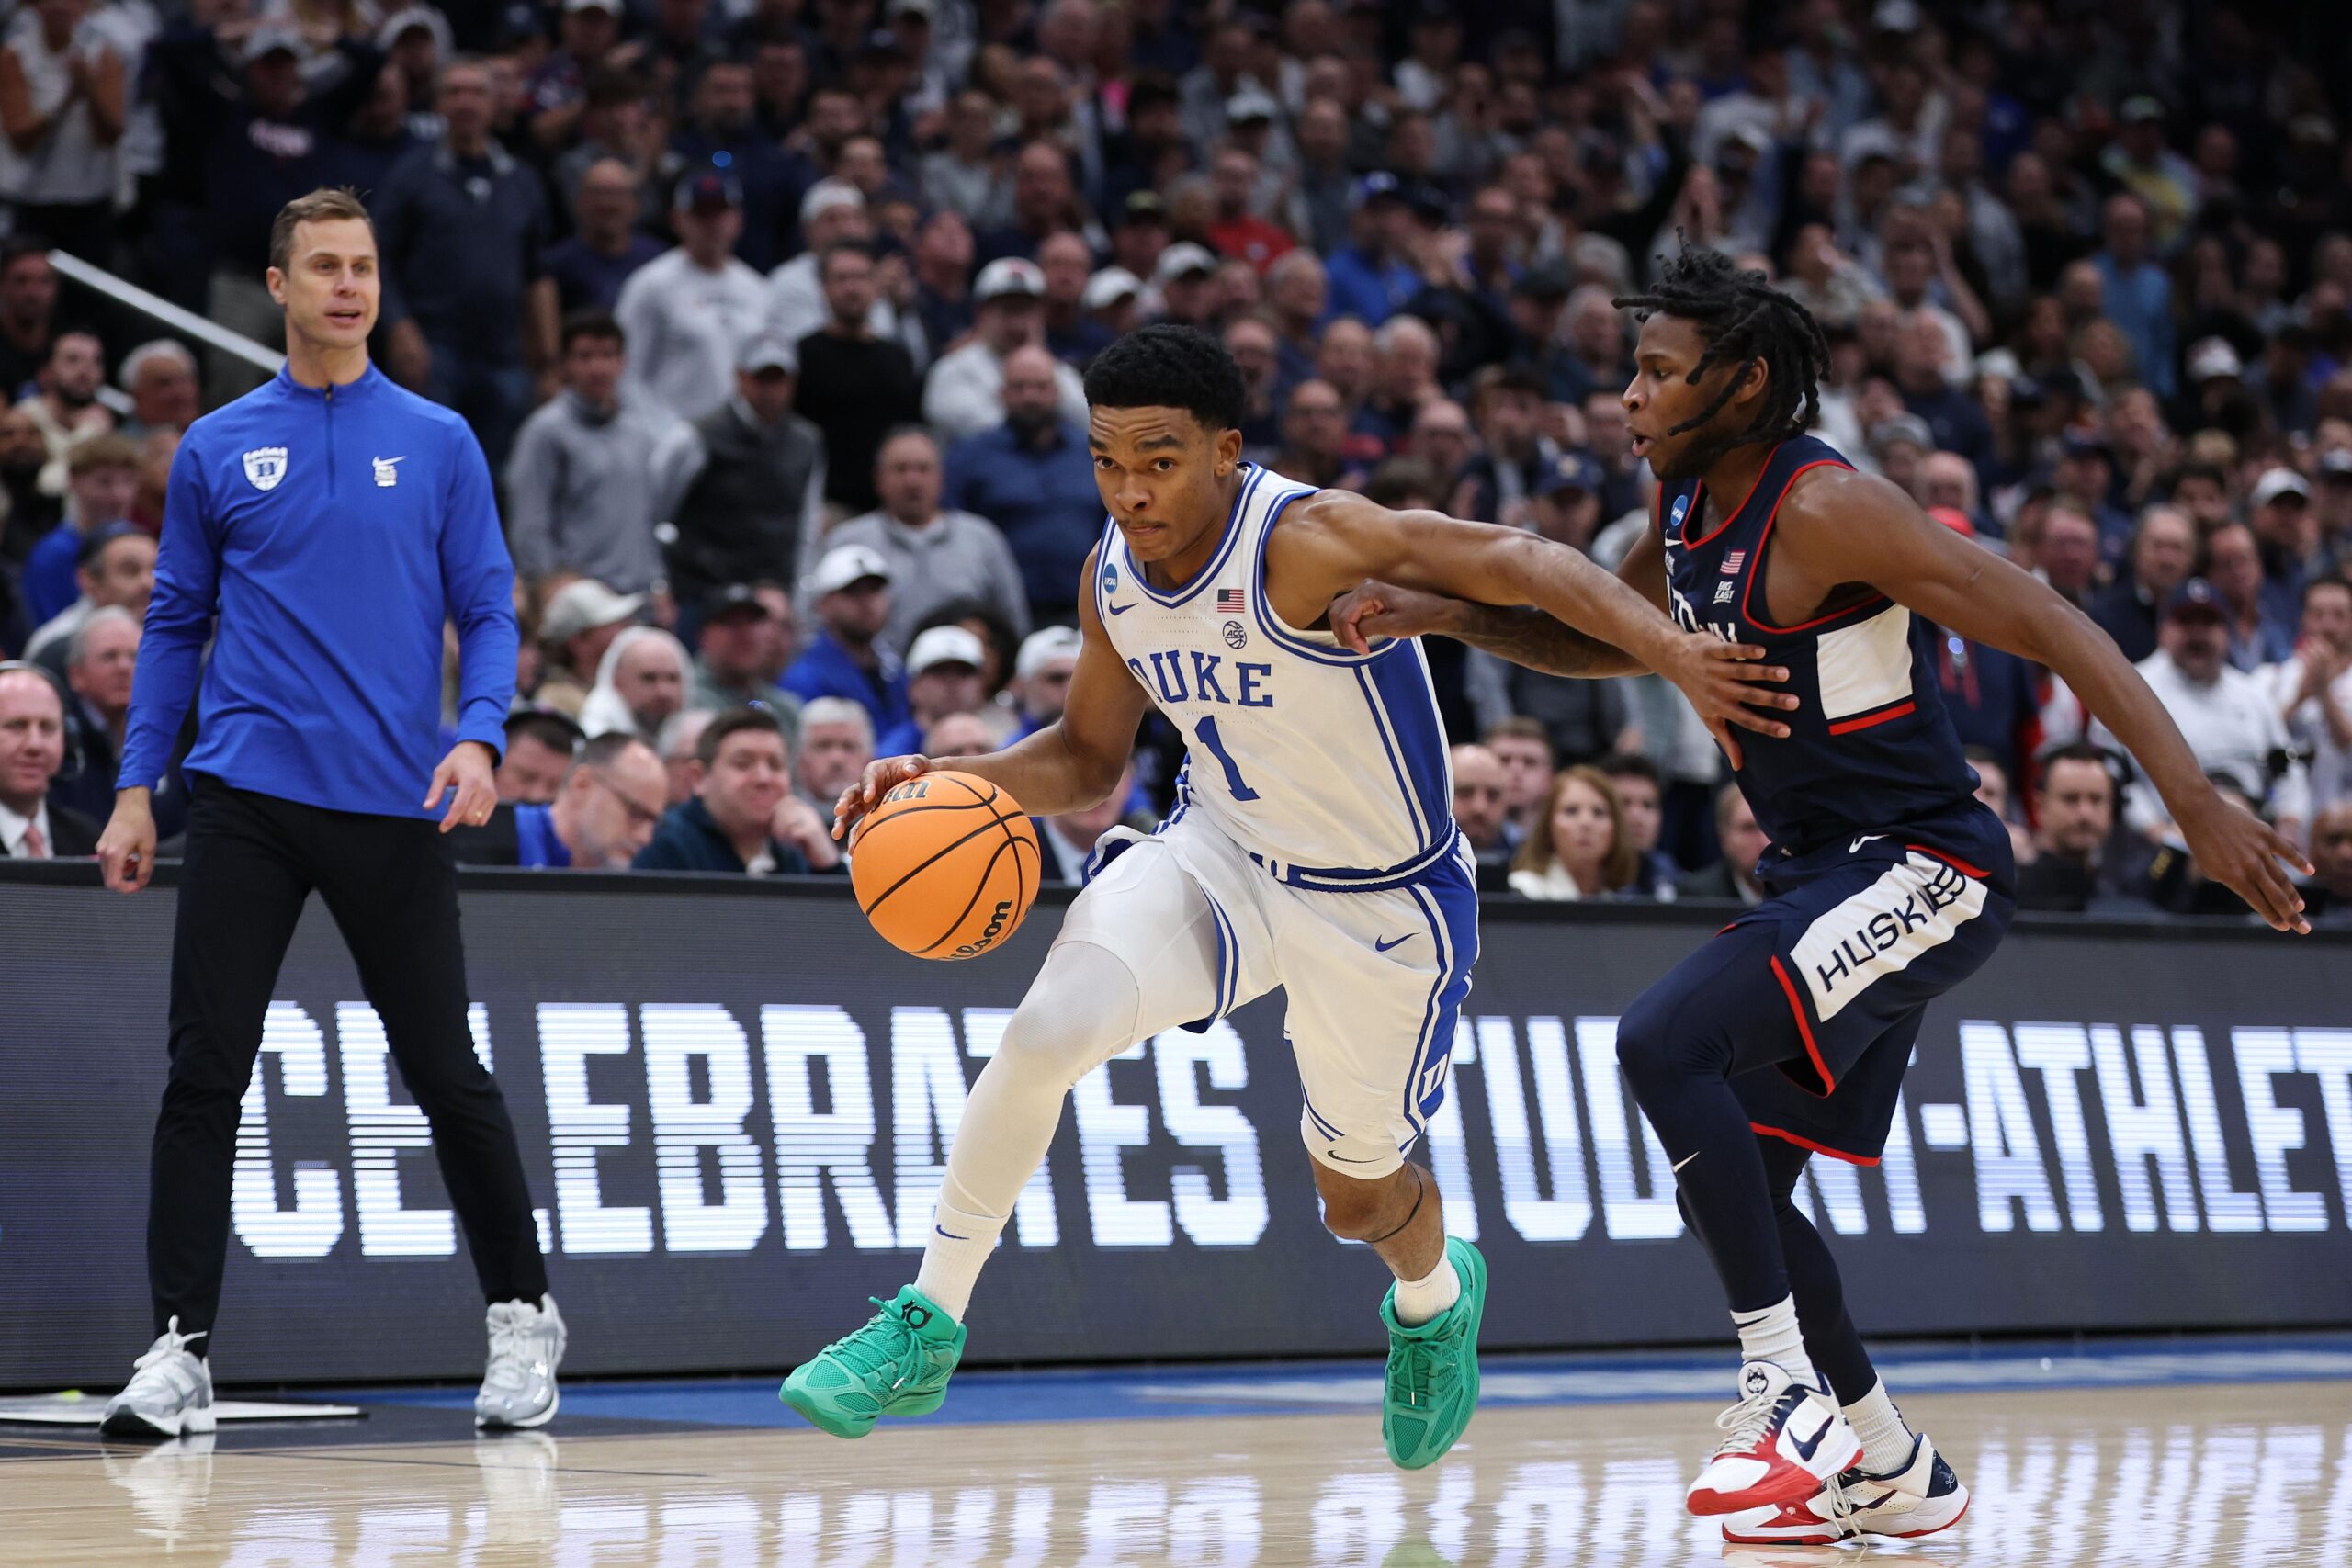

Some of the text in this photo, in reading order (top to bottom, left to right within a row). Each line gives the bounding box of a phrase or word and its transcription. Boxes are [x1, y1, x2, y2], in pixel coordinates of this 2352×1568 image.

[1714, 590, 1736, 600] EAST
[1226, 629, 1245, 638] ACC
[1194, 714, 1261, 802] 1
[231, 1000, 1272, 1258] CEEBRAES
